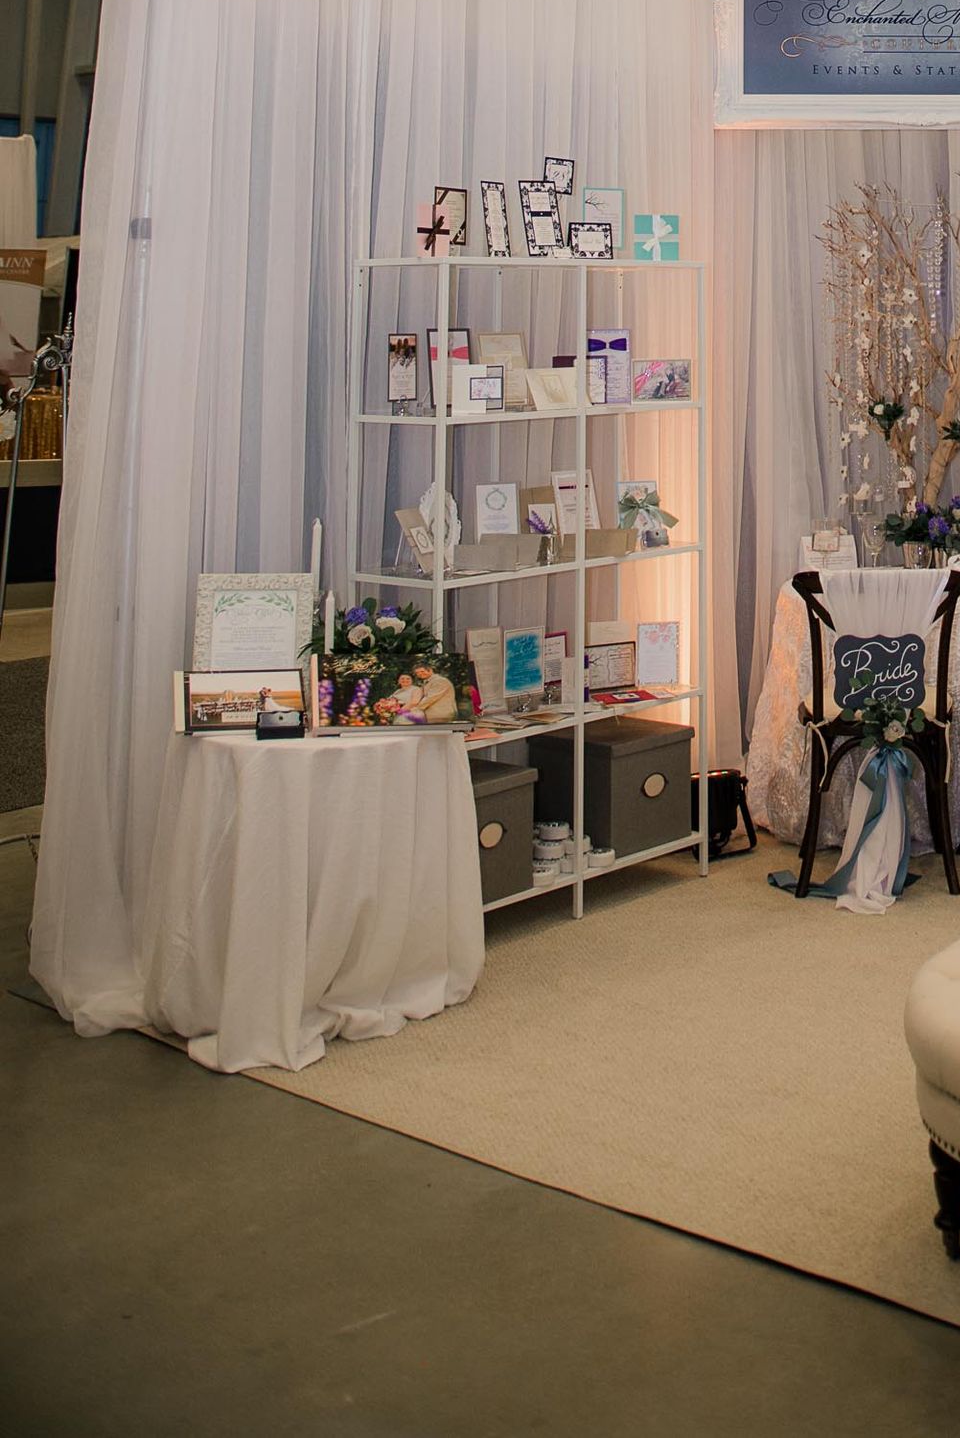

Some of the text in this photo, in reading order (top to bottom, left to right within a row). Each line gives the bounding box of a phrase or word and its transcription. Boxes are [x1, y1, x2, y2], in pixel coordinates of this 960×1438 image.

[812, 64, 880, 76] EVENTS
[893, 65, 903, 76] &
[841, 640, 918, 704] Bride
